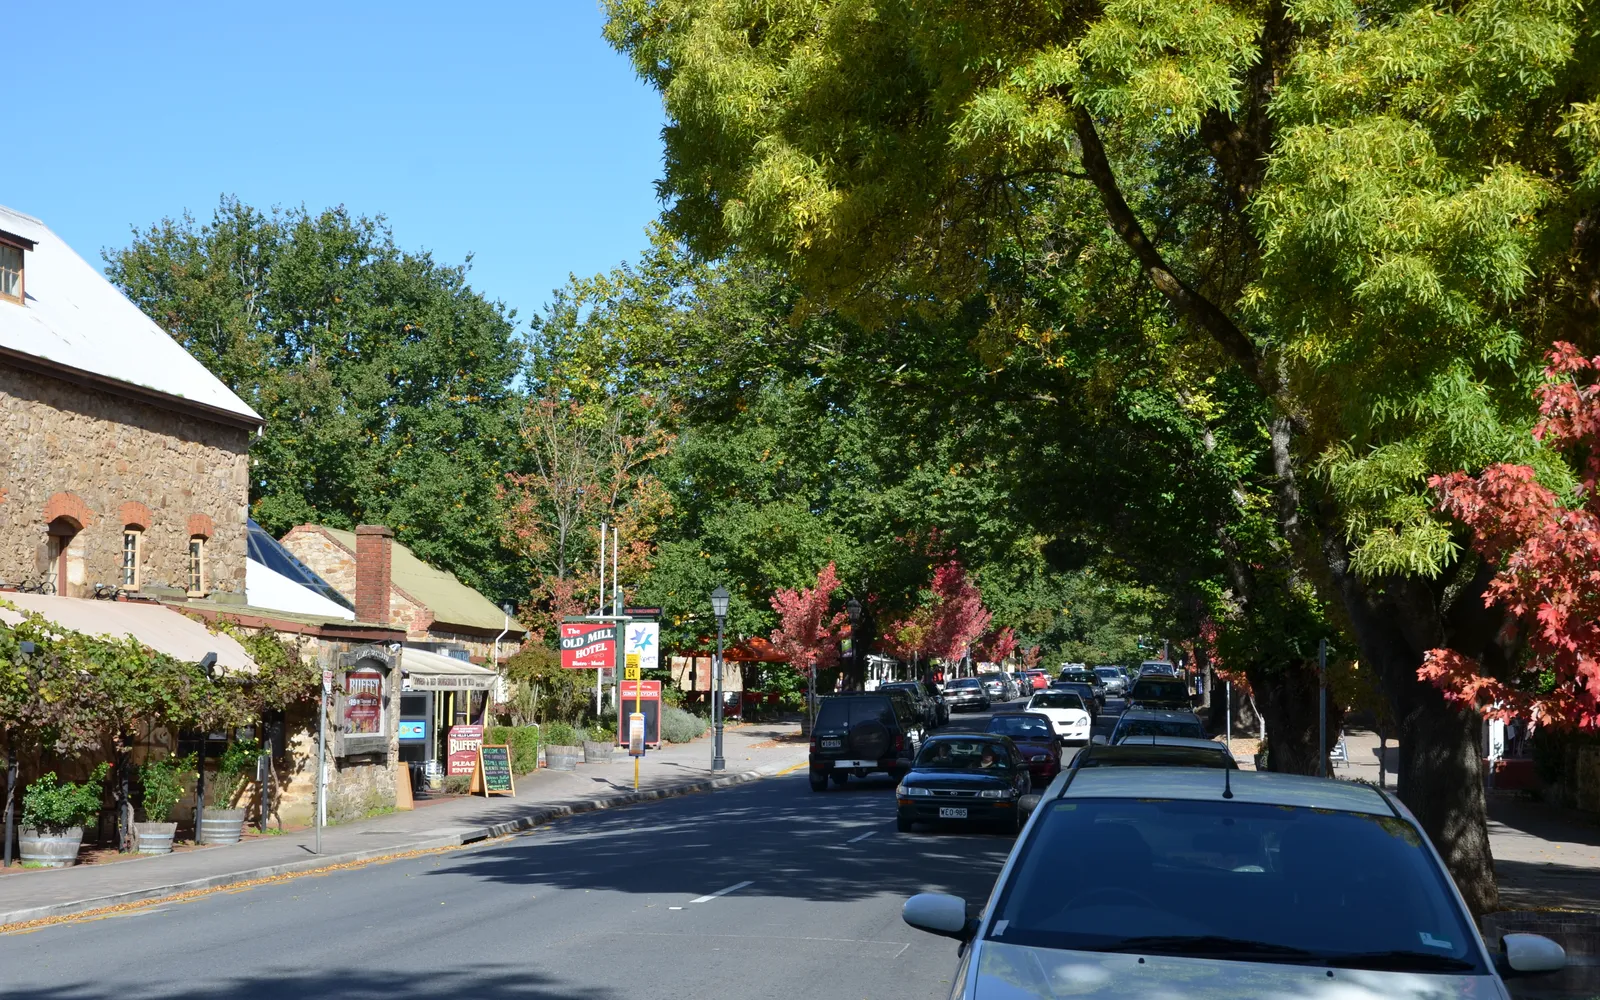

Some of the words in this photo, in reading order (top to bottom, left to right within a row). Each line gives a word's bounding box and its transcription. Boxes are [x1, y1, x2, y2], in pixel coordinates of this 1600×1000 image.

[562, 637, 584, 648] OLD
[587, 629, 614, 643] MILL
[575, 643, 607, 659] HOTEL
[628, 669, 635, 677] 54
[349, 678, 380, 697] BUFFET
[450, 739, 482, 755] BUFFET
